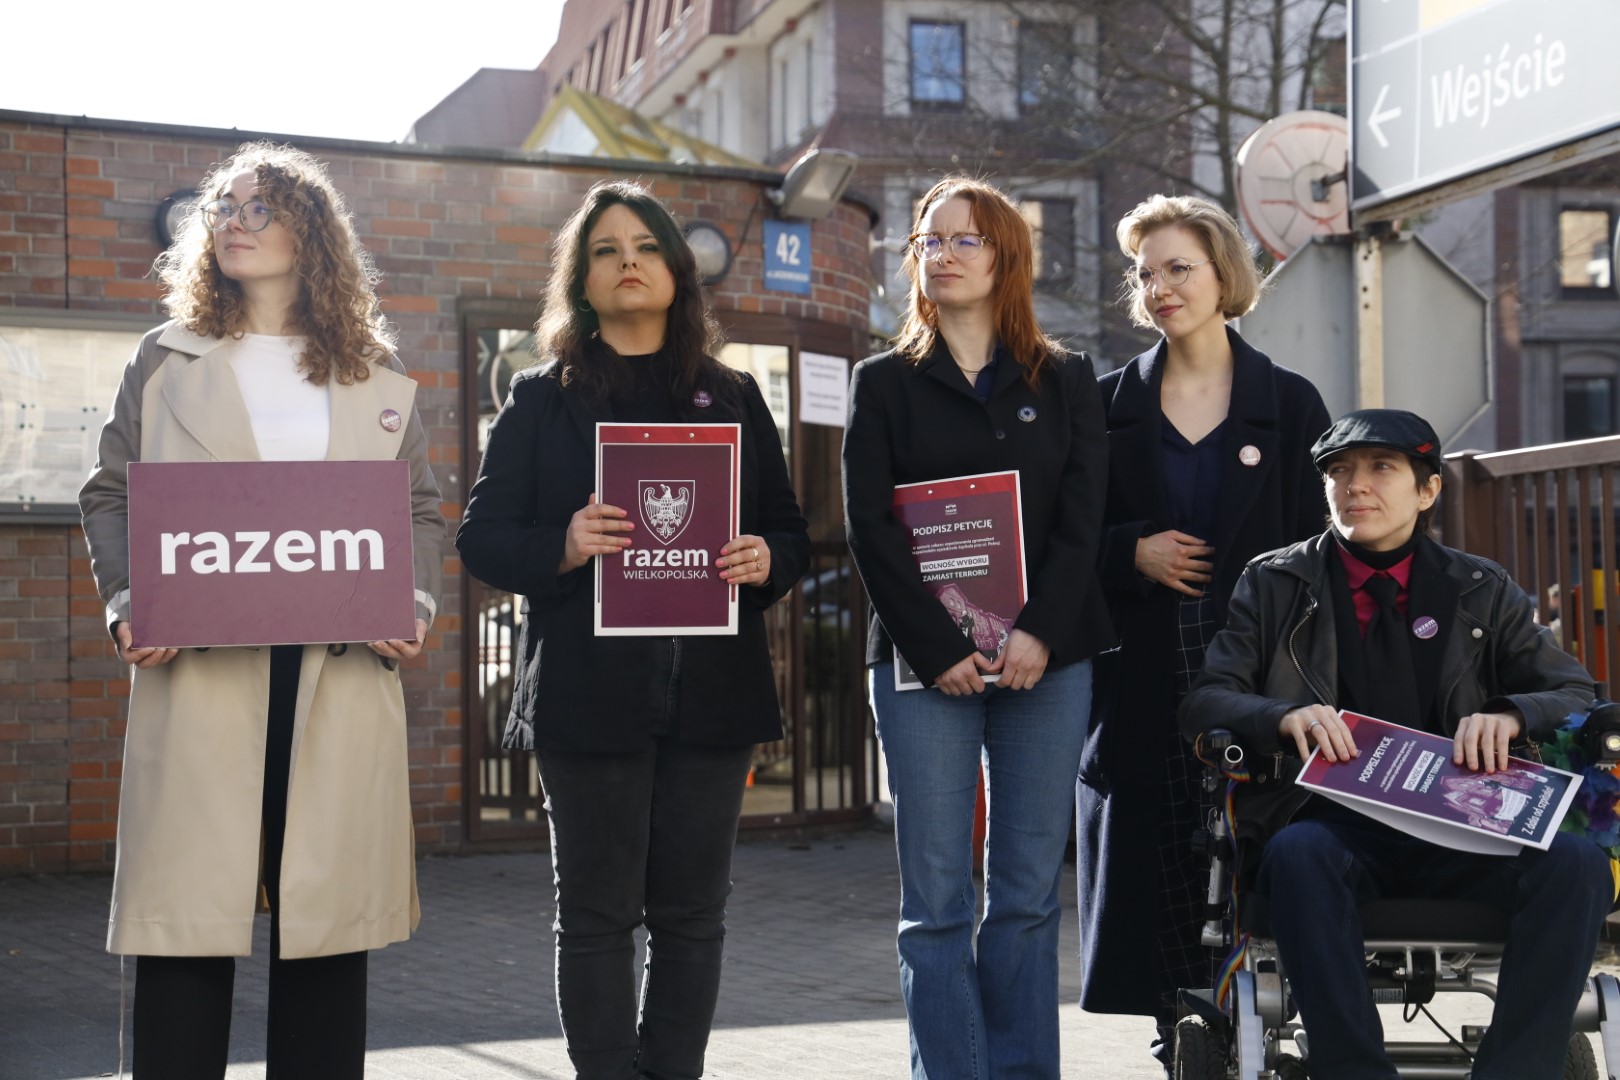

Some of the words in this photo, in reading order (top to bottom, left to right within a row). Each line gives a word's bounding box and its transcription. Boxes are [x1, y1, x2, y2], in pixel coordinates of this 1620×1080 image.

[1431, 33, 1566, 129] Wejście
[776, 232, 801, 267] 42
[913, 524, 952, 536] PODPISZ
[954, 519, 992, 531] PETYCJĘ
[160, 528, 385, 575] razem
[623, 548, 709, 567] razem
[922, 560, 955, 570] WOLNOŚĆ
[957, 557, 987, 566] WYBORU
[623, 570, 709, 580] WIELKOPOLSKA
[922, 572, 953, 582] ZAMIAST
[954, 569, 988, 578] TERRORU
[1358, 757, 1380, 783] PODPISZ
[1521, 827, 1533, 835] Z
[1533, 807, 1543, 817] od
